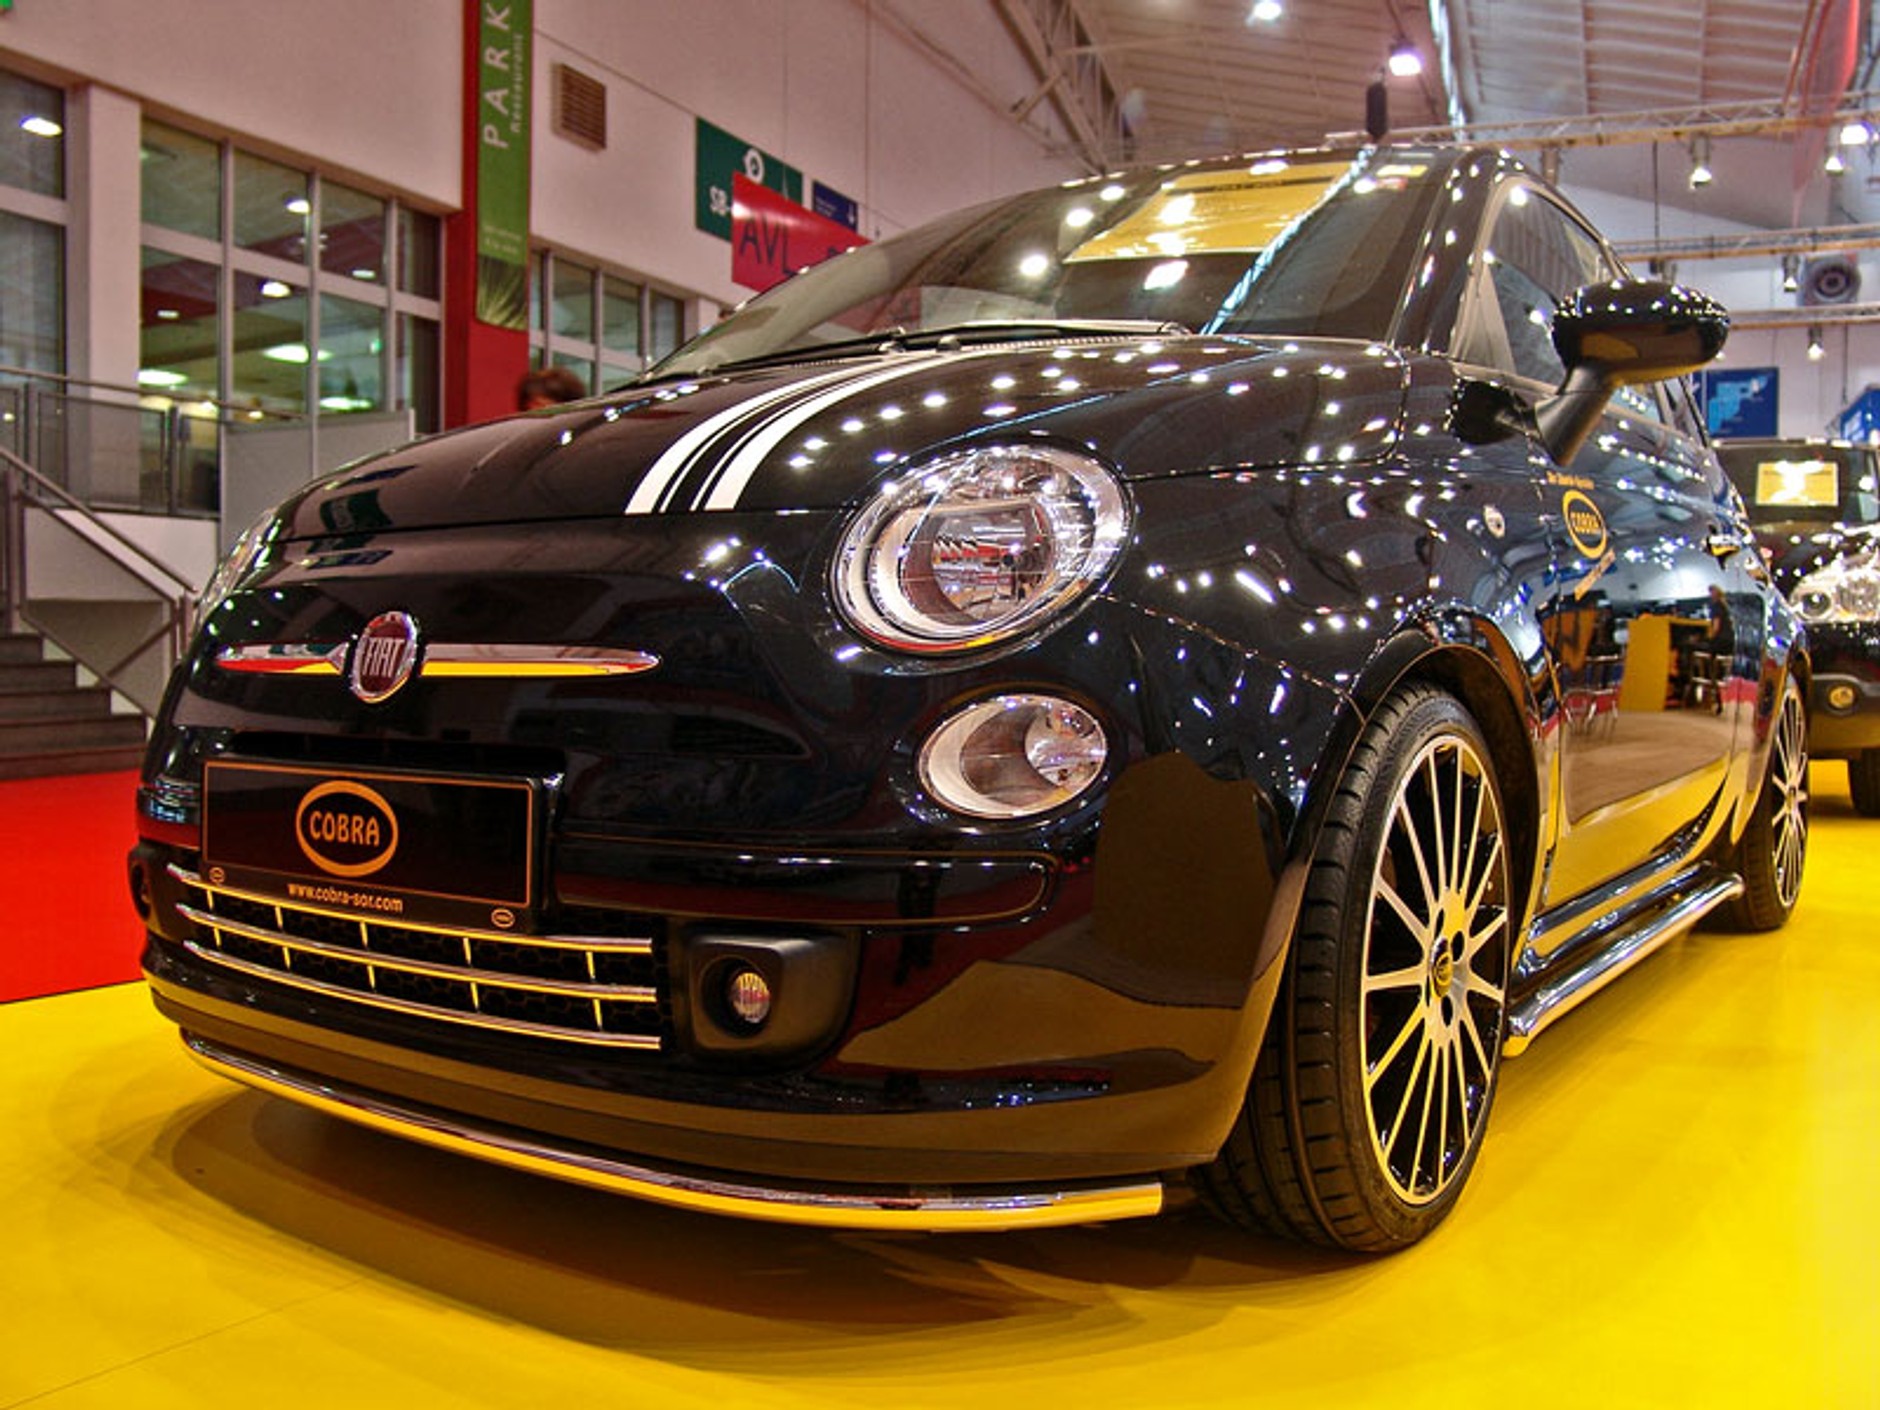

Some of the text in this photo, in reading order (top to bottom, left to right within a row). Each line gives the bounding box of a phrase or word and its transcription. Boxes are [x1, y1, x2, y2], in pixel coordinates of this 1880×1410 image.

[484, 1, 510, 150] PARK
[362, 637, 405, 678] FIAT
[309, 810, 381, 848] COBRA
[287, 883, 404, 912] www.cobra-sor.com
